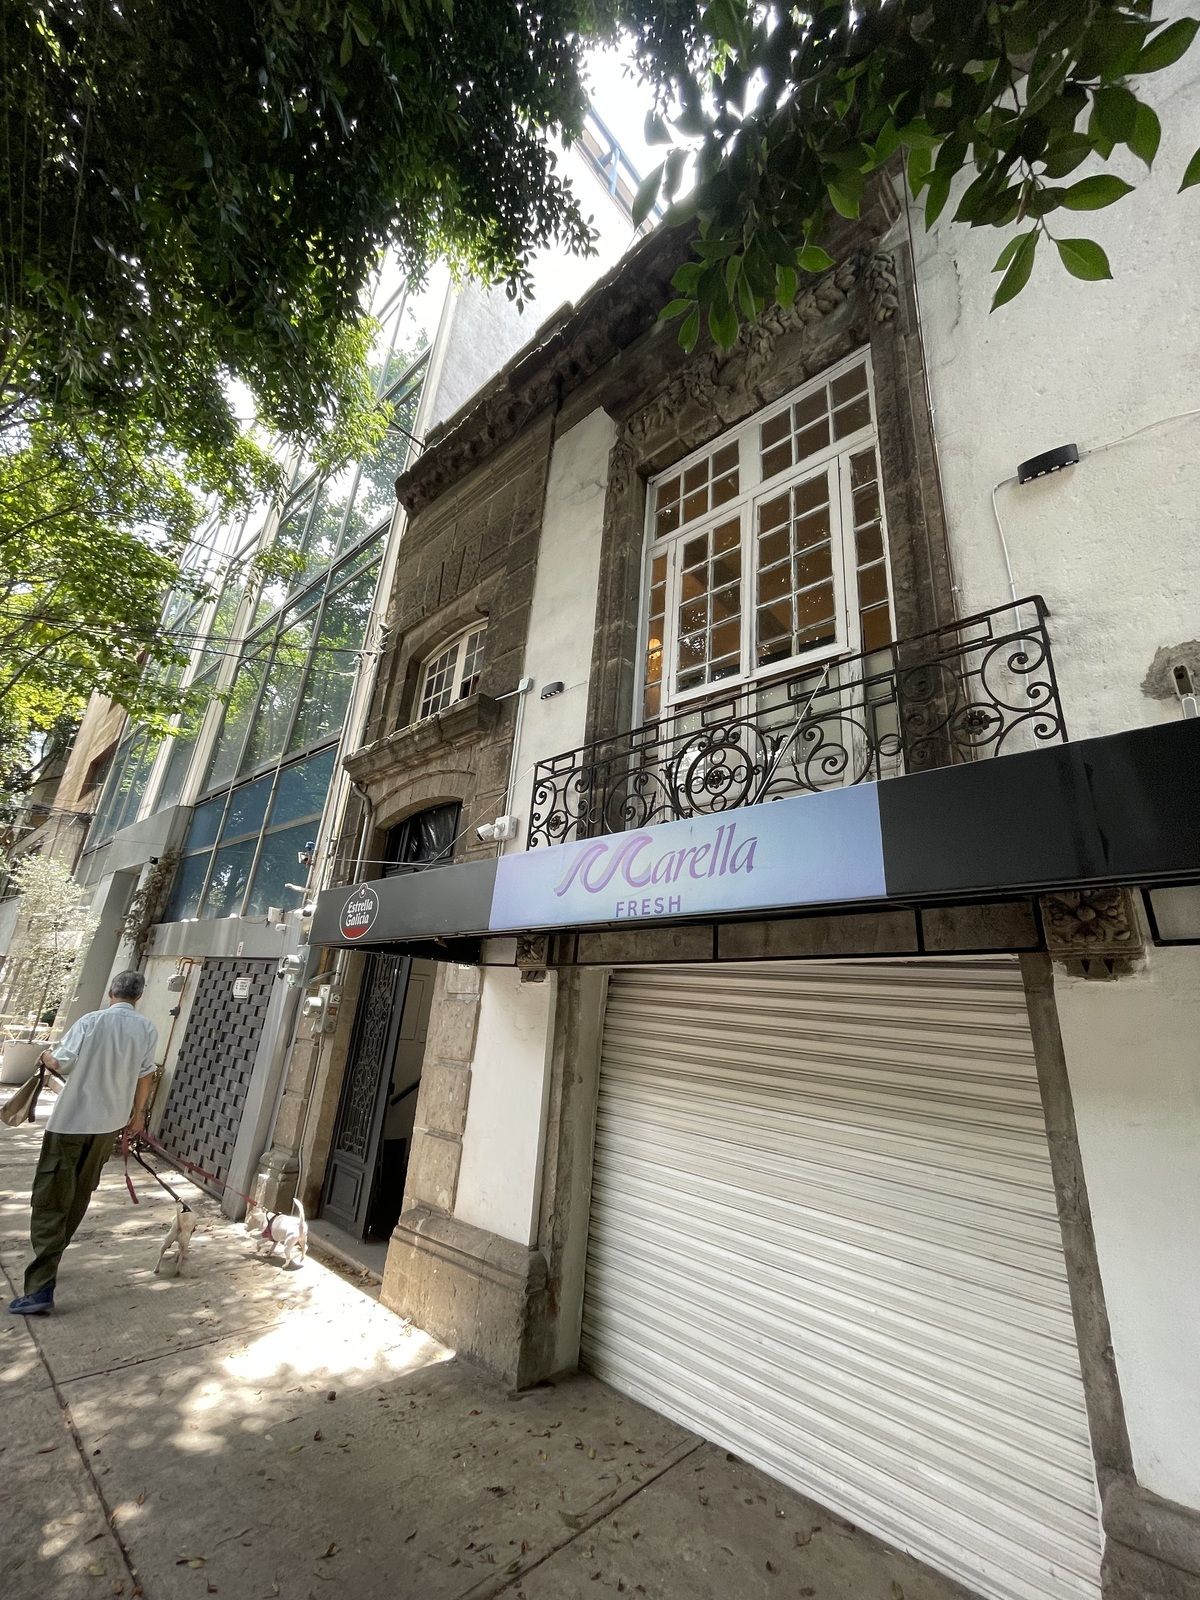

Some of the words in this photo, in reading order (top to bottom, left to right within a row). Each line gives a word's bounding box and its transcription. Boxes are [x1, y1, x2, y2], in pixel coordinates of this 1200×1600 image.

[554, 822, 758, 897] Marella
[347, 898, 374, 914] Estrella
[615, 895, 681, 918] FRESH
[345, 911, 370, 927] Galicia
